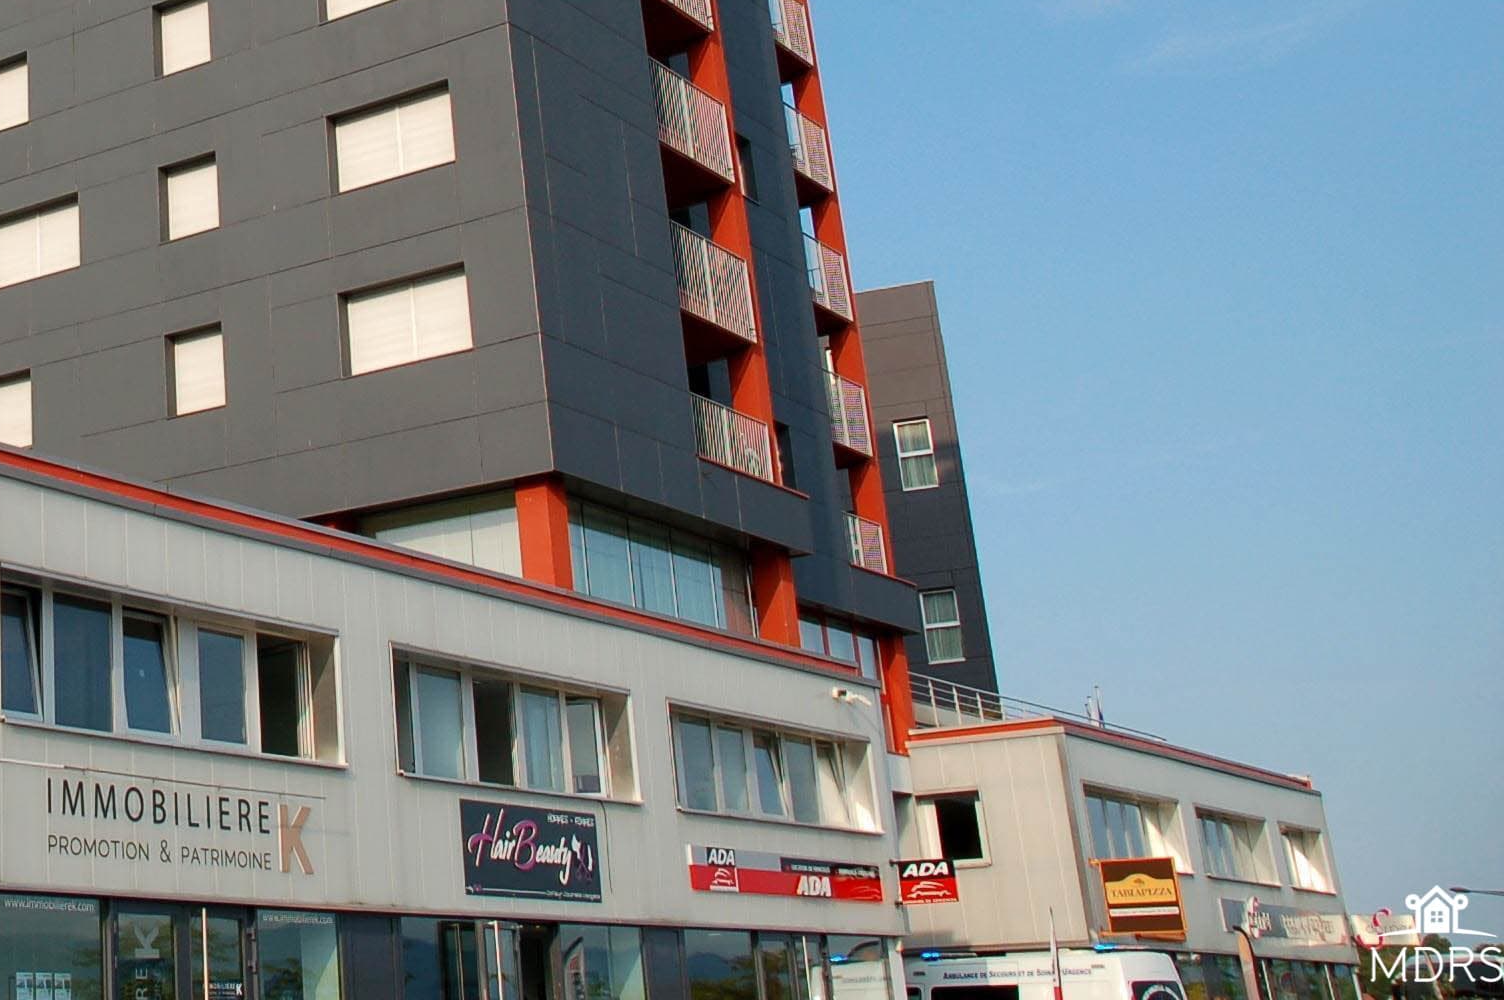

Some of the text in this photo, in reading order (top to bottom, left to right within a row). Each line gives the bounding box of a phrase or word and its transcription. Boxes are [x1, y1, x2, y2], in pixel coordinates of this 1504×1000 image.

[48, 777, 314, 875] IMMOBILIERE K
[48, 834, 272, 870] PROMOTION & PATRIMOINE
[708, 848, 735, 866] ADA
[902, 861, 949, 878] ADA
[796, 875, 832, 897] ADA
